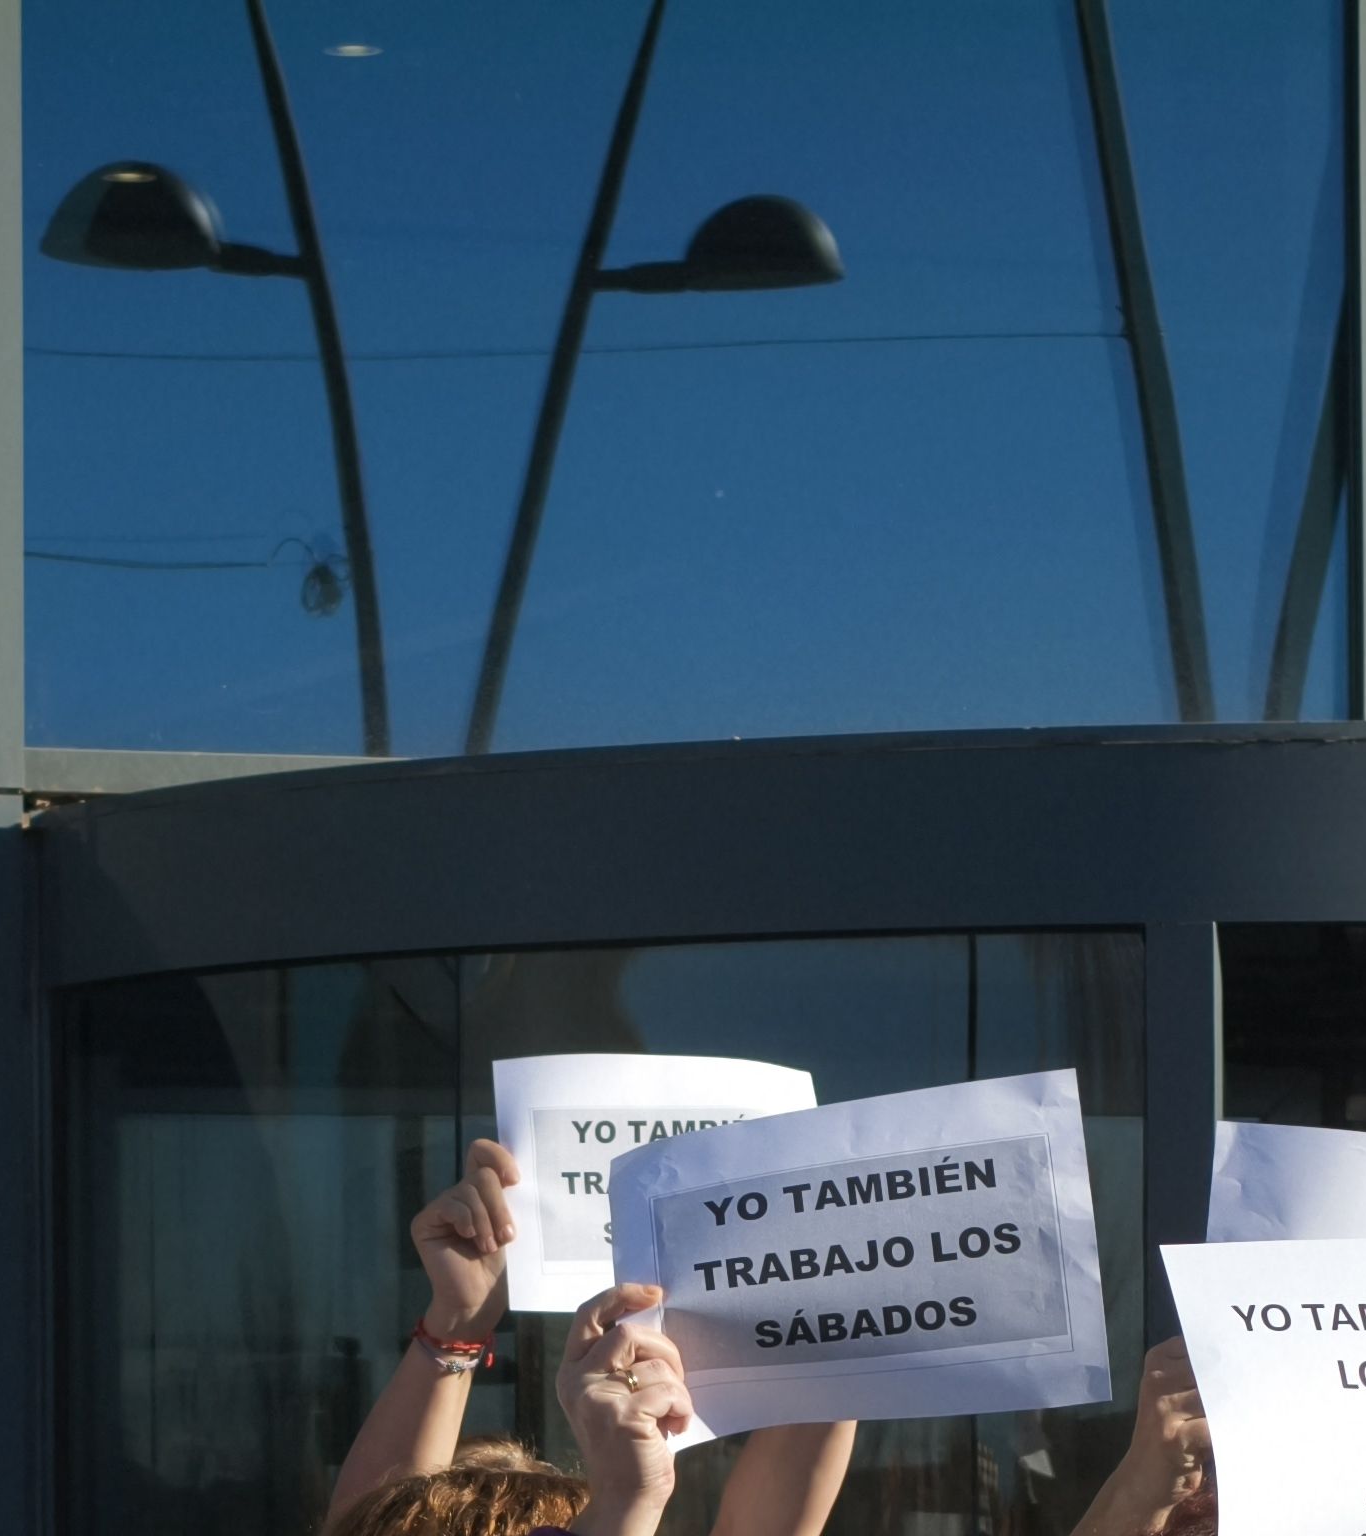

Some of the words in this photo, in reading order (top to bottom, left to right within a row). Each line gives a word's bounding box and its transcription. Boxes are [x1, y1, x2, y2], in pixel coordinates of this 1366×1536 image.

[572, 1121, 616, 1144] YO
[704, 1192, 767, 1226] YO
[783, 1156, 996, 1213] TAMBIÉN
[694, 1237, 914, 1291] TRABAJO
[931, 1223, 1021, 1262] LOS
[756, 1296, 977, 1347] SÁBADOS
[1232, 1304, 1291, 1331] YO
